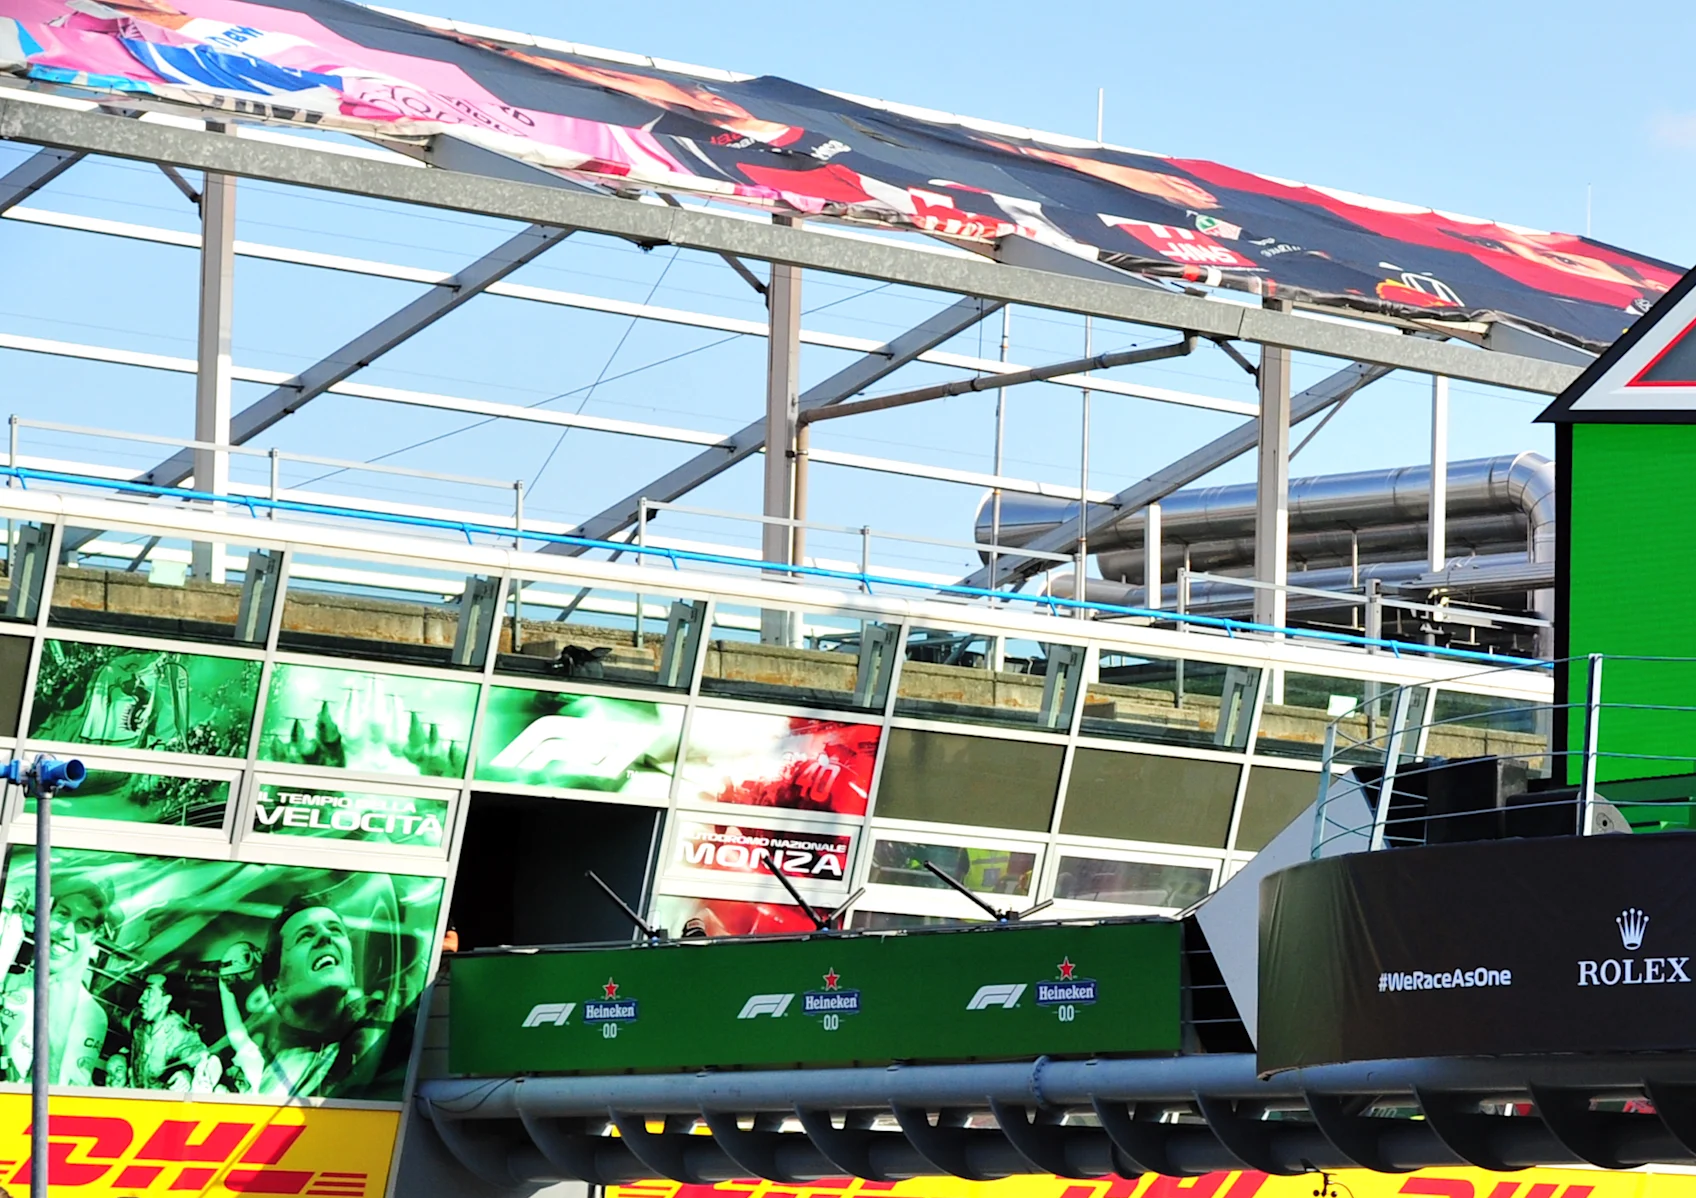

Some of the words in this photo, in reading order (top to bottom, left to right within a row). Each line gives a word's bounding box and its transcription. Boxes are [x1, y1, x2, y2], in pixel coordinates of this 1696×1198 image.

[258, 791, 273, 802] IL
[278, 792, 350, 807] TEMPIO
[256, 804, 443, 837] VELOCITÀ
[770, 838, 847, 853] NAZIONALE
[677, 841, 842, 876] MONZA
[1378, 966, 1512, 991] #WeRaceAsOne
[1577, 957, 1691, 986] ROLEX
[805, 994, 858, 1011] Heineken
[1038, 984, 1095, 1001] Heineken
[586, 1002, 635, 1019] Heineken
[9, 1117, 314, 1197] DHL
